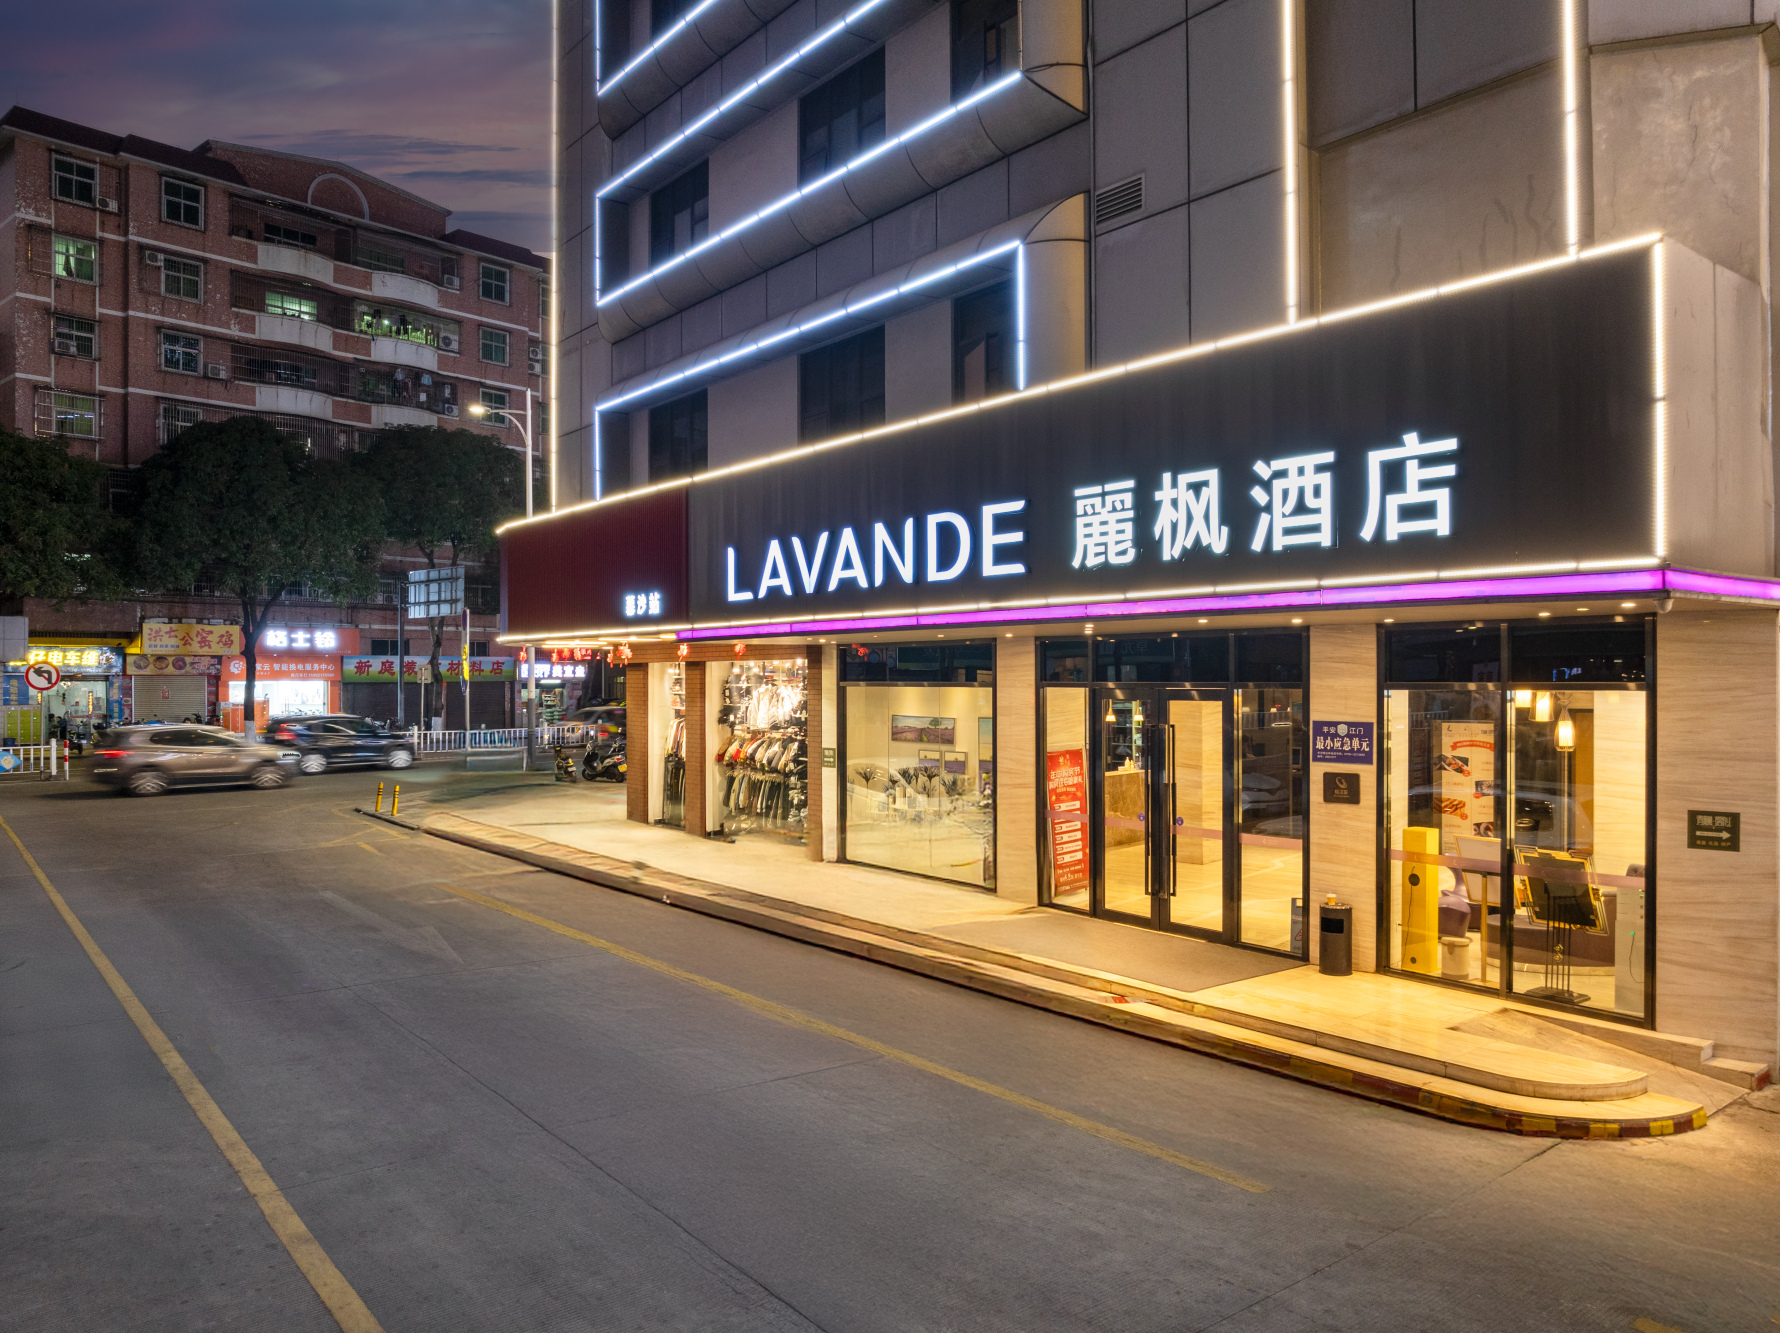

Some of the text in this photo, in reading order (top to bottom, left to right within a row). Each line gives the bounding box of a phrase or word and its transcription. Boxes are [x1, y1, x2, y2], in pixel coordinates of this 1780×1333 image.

[727, 431, 1459, 602] LAVANDE 麗枫酒店
[1322, 726, 1363, 735] 平安 江门
[1315, 736, 1370, 751] 最小应急单元
